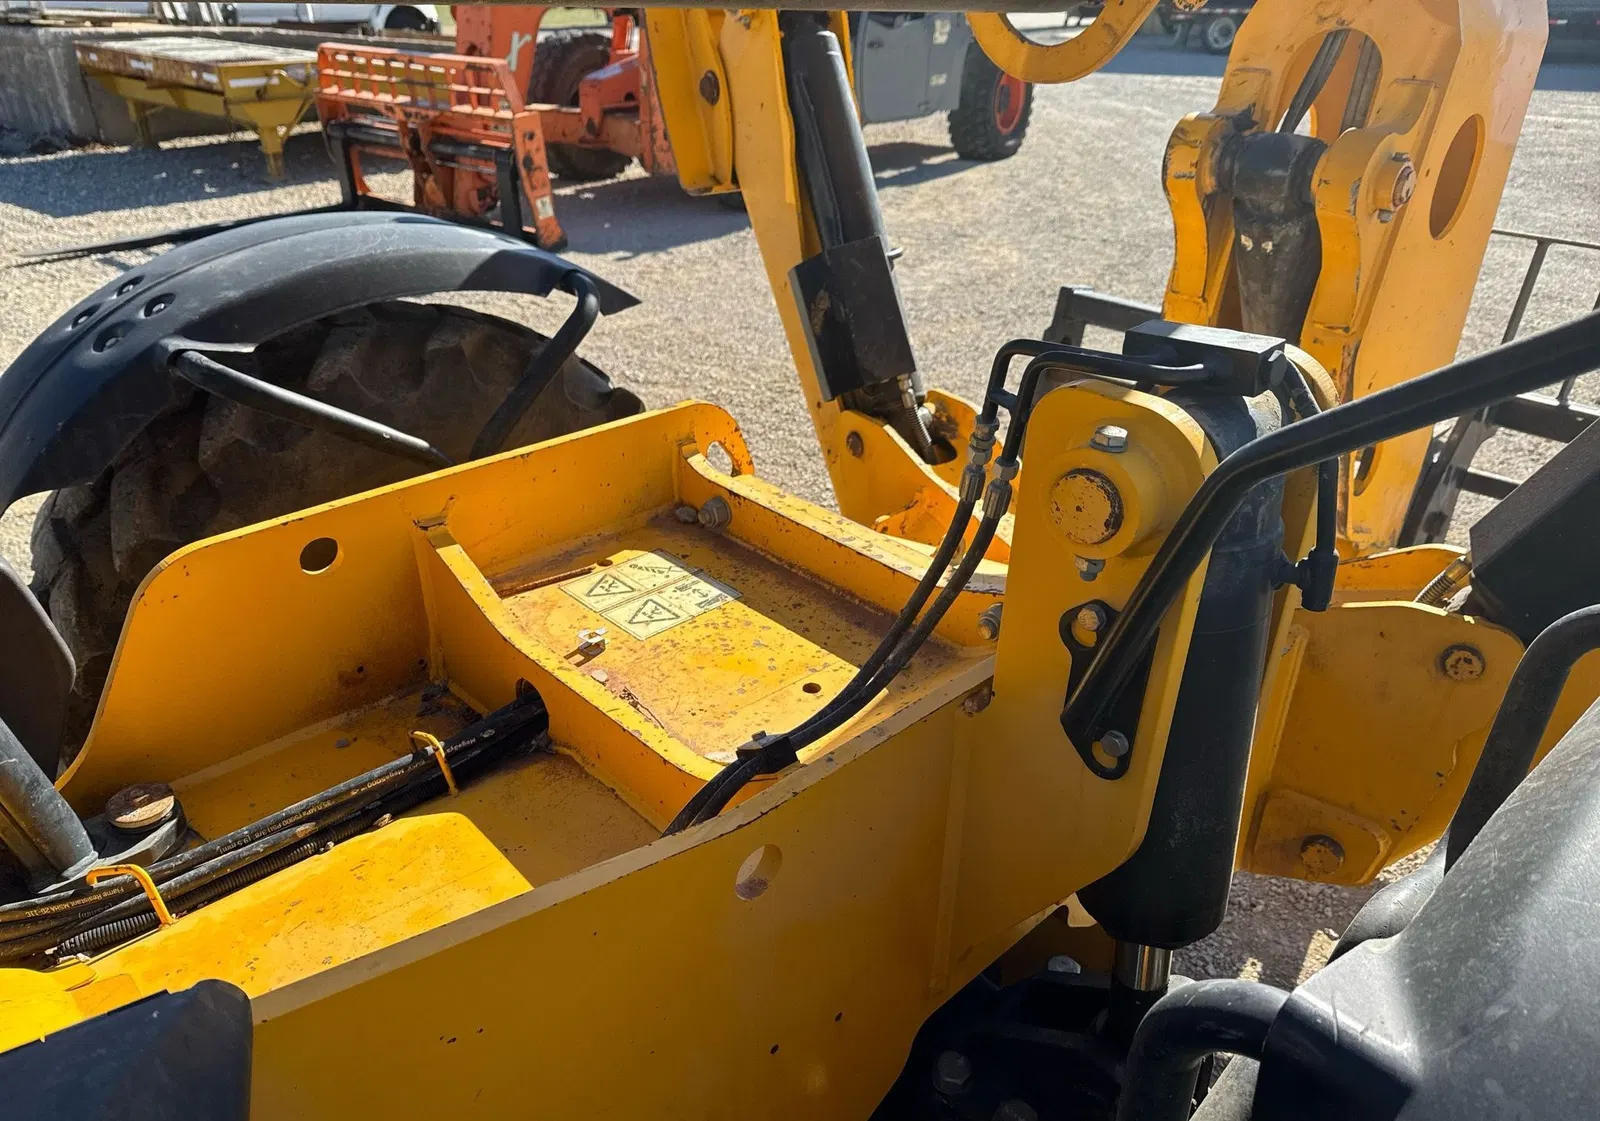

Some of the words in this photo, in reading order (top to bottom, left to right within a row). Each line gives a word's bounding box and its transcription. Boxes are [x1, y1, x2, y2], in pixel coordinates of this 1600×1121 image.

[102, 887, 124, 898] Flame
[70, 894, 102, 906] Resistant
[50, 902, 69, 912] MSHA
